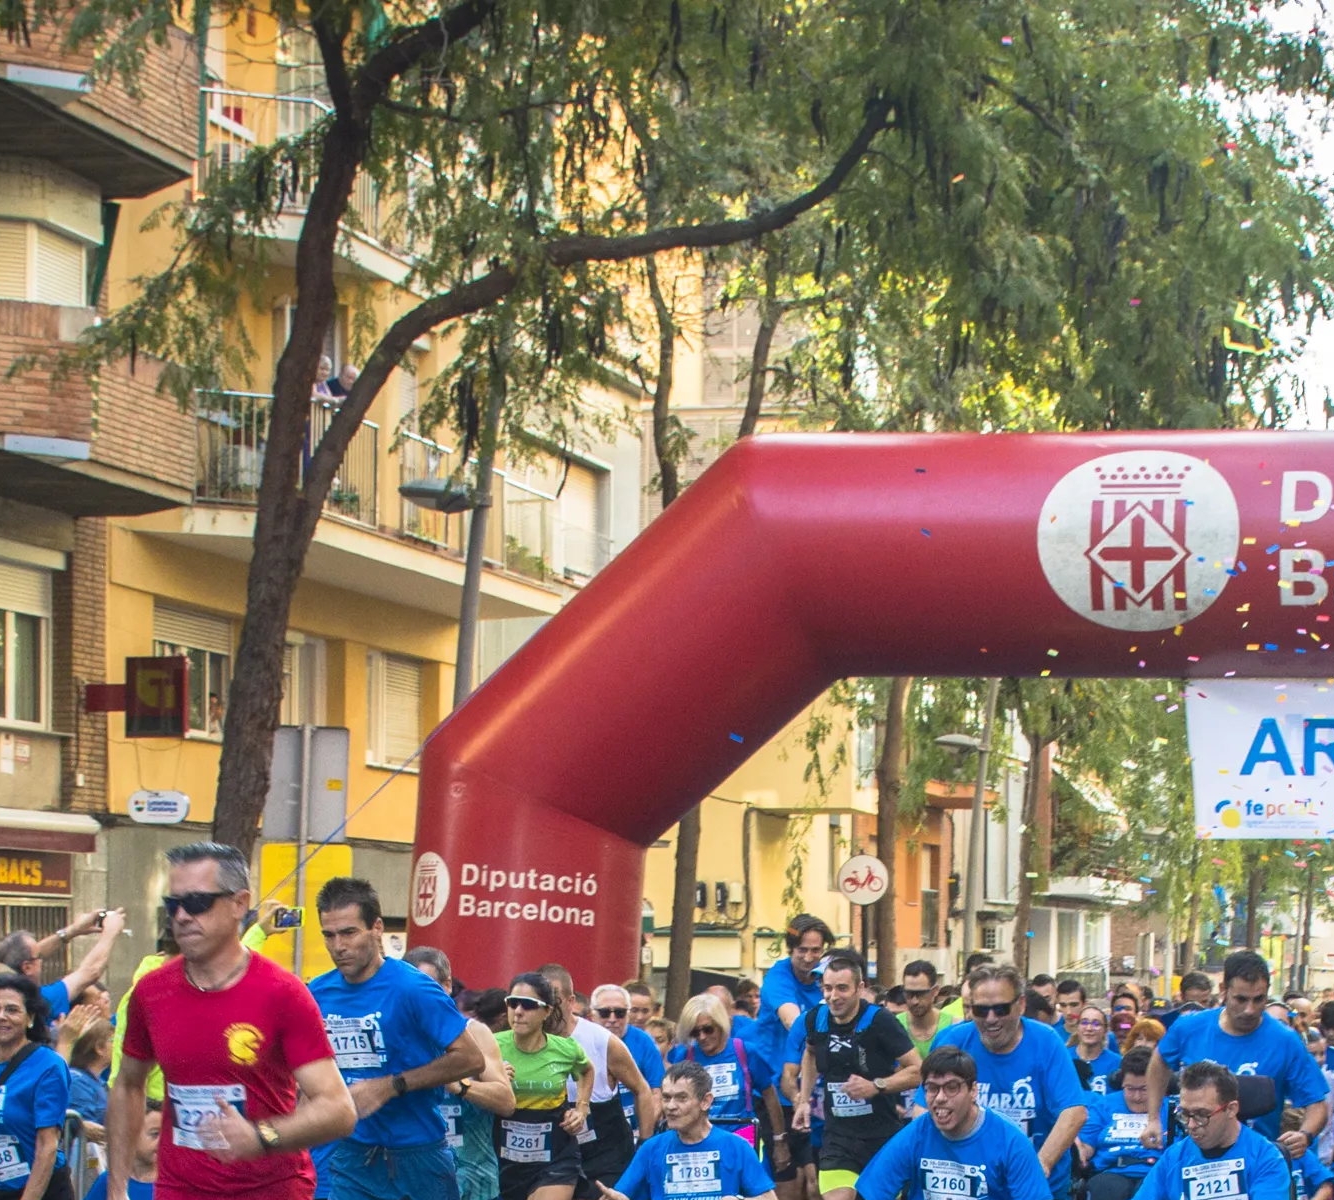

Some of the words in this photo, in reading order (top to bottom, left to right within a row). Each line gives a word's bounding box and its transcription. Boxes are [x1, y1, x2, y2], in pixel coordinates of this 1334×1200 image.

[461, 863, 598, 896] Diputació
[458, 893, 596, 927] Barcelona
[333, 1035, 367, 1050] 1715
[976, 1092, 1036, 1109] MARXA
[510, 1135, 540, 1149] 2261
[678, 1166, 710, 1179] 1789
[931, 1176, 966, 1191] 2160
[1196, 1178, 1231, 1197] 2121
